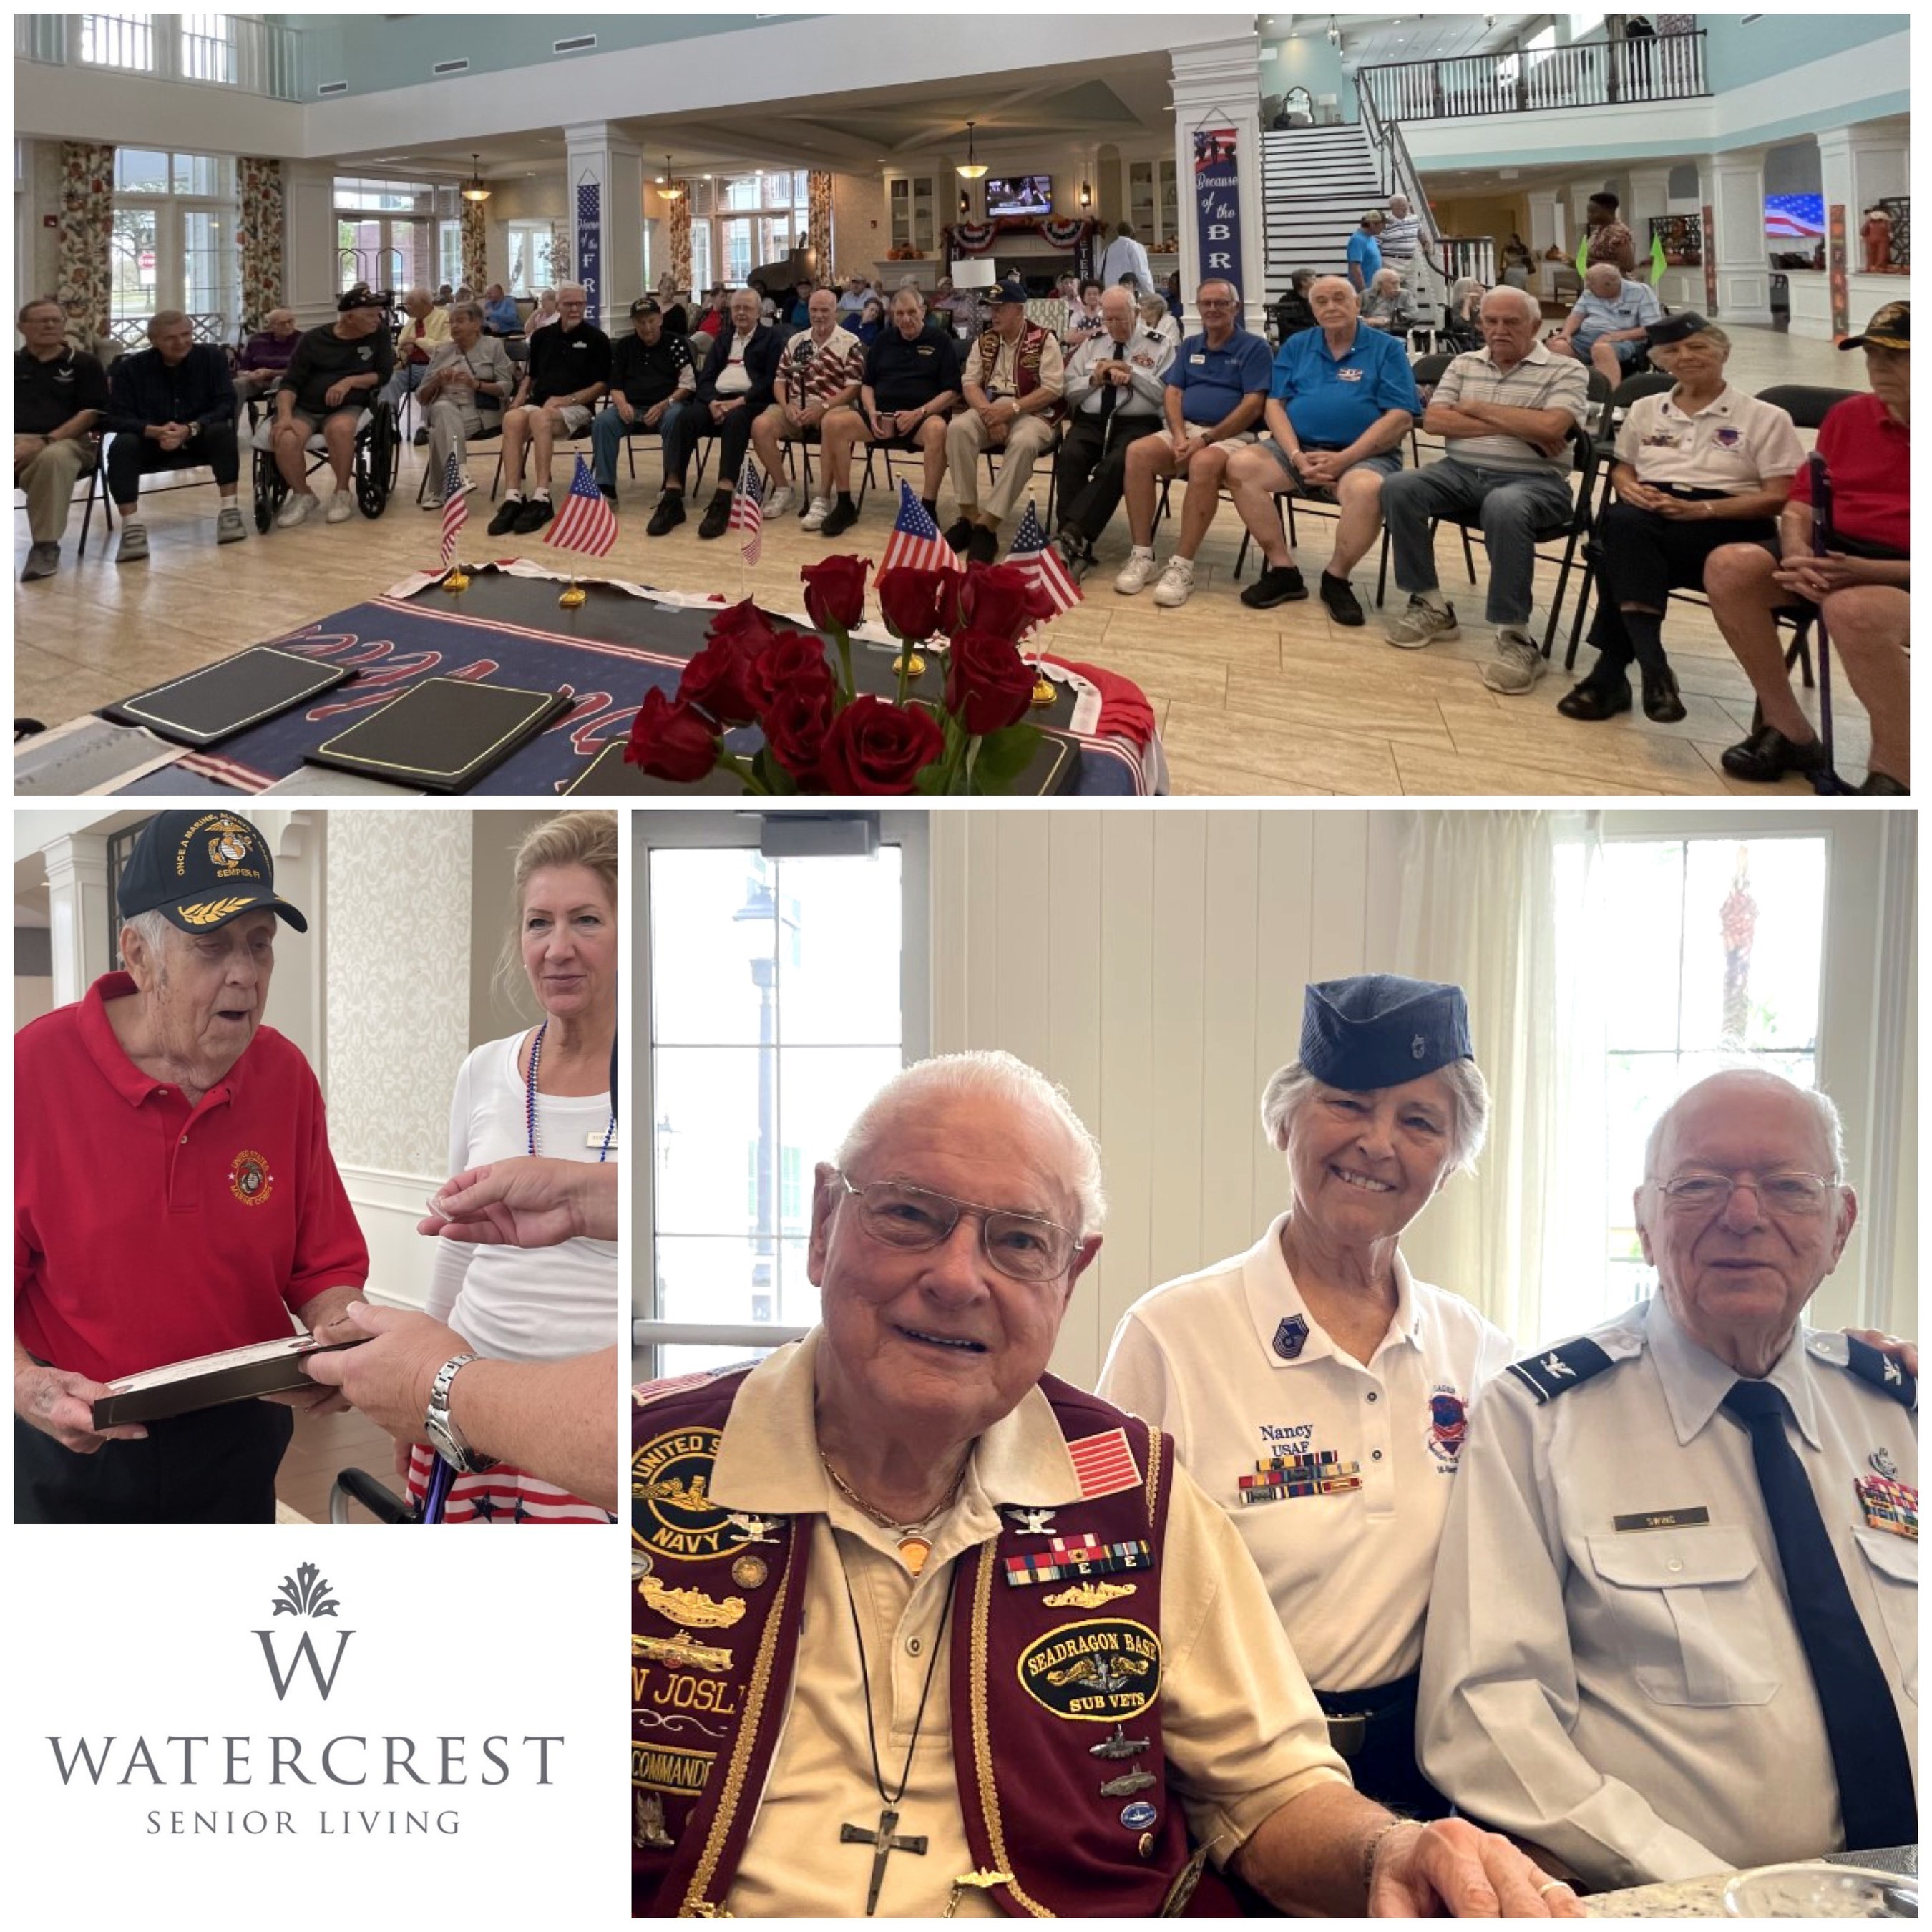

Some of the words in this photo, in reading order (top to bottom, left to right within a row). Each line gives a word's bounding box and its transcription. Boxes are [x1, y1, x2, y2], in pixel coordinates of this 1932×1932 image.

[1196, 172, 1238, 190] Because
[1201, 190, 1215, 214] of
[1216, 203, 1235, 218] the
[177, 849, 185, 876] ONCE
[1259, 1424, 1314, 1442] Nancy
[634, 1436, 703, 1478] UNITED
[1271, 1440, 1309, 1458] USAF
[651, 1527, 720, 1553] NAVY
[1027, 1634, 1119, 1677] SEADRAGON
[1123, 1634, 1158, 1662] BASE
[1069, 1694, 1104, 1712] SUB
[1107, 1692, 1146, 1709] VETS
